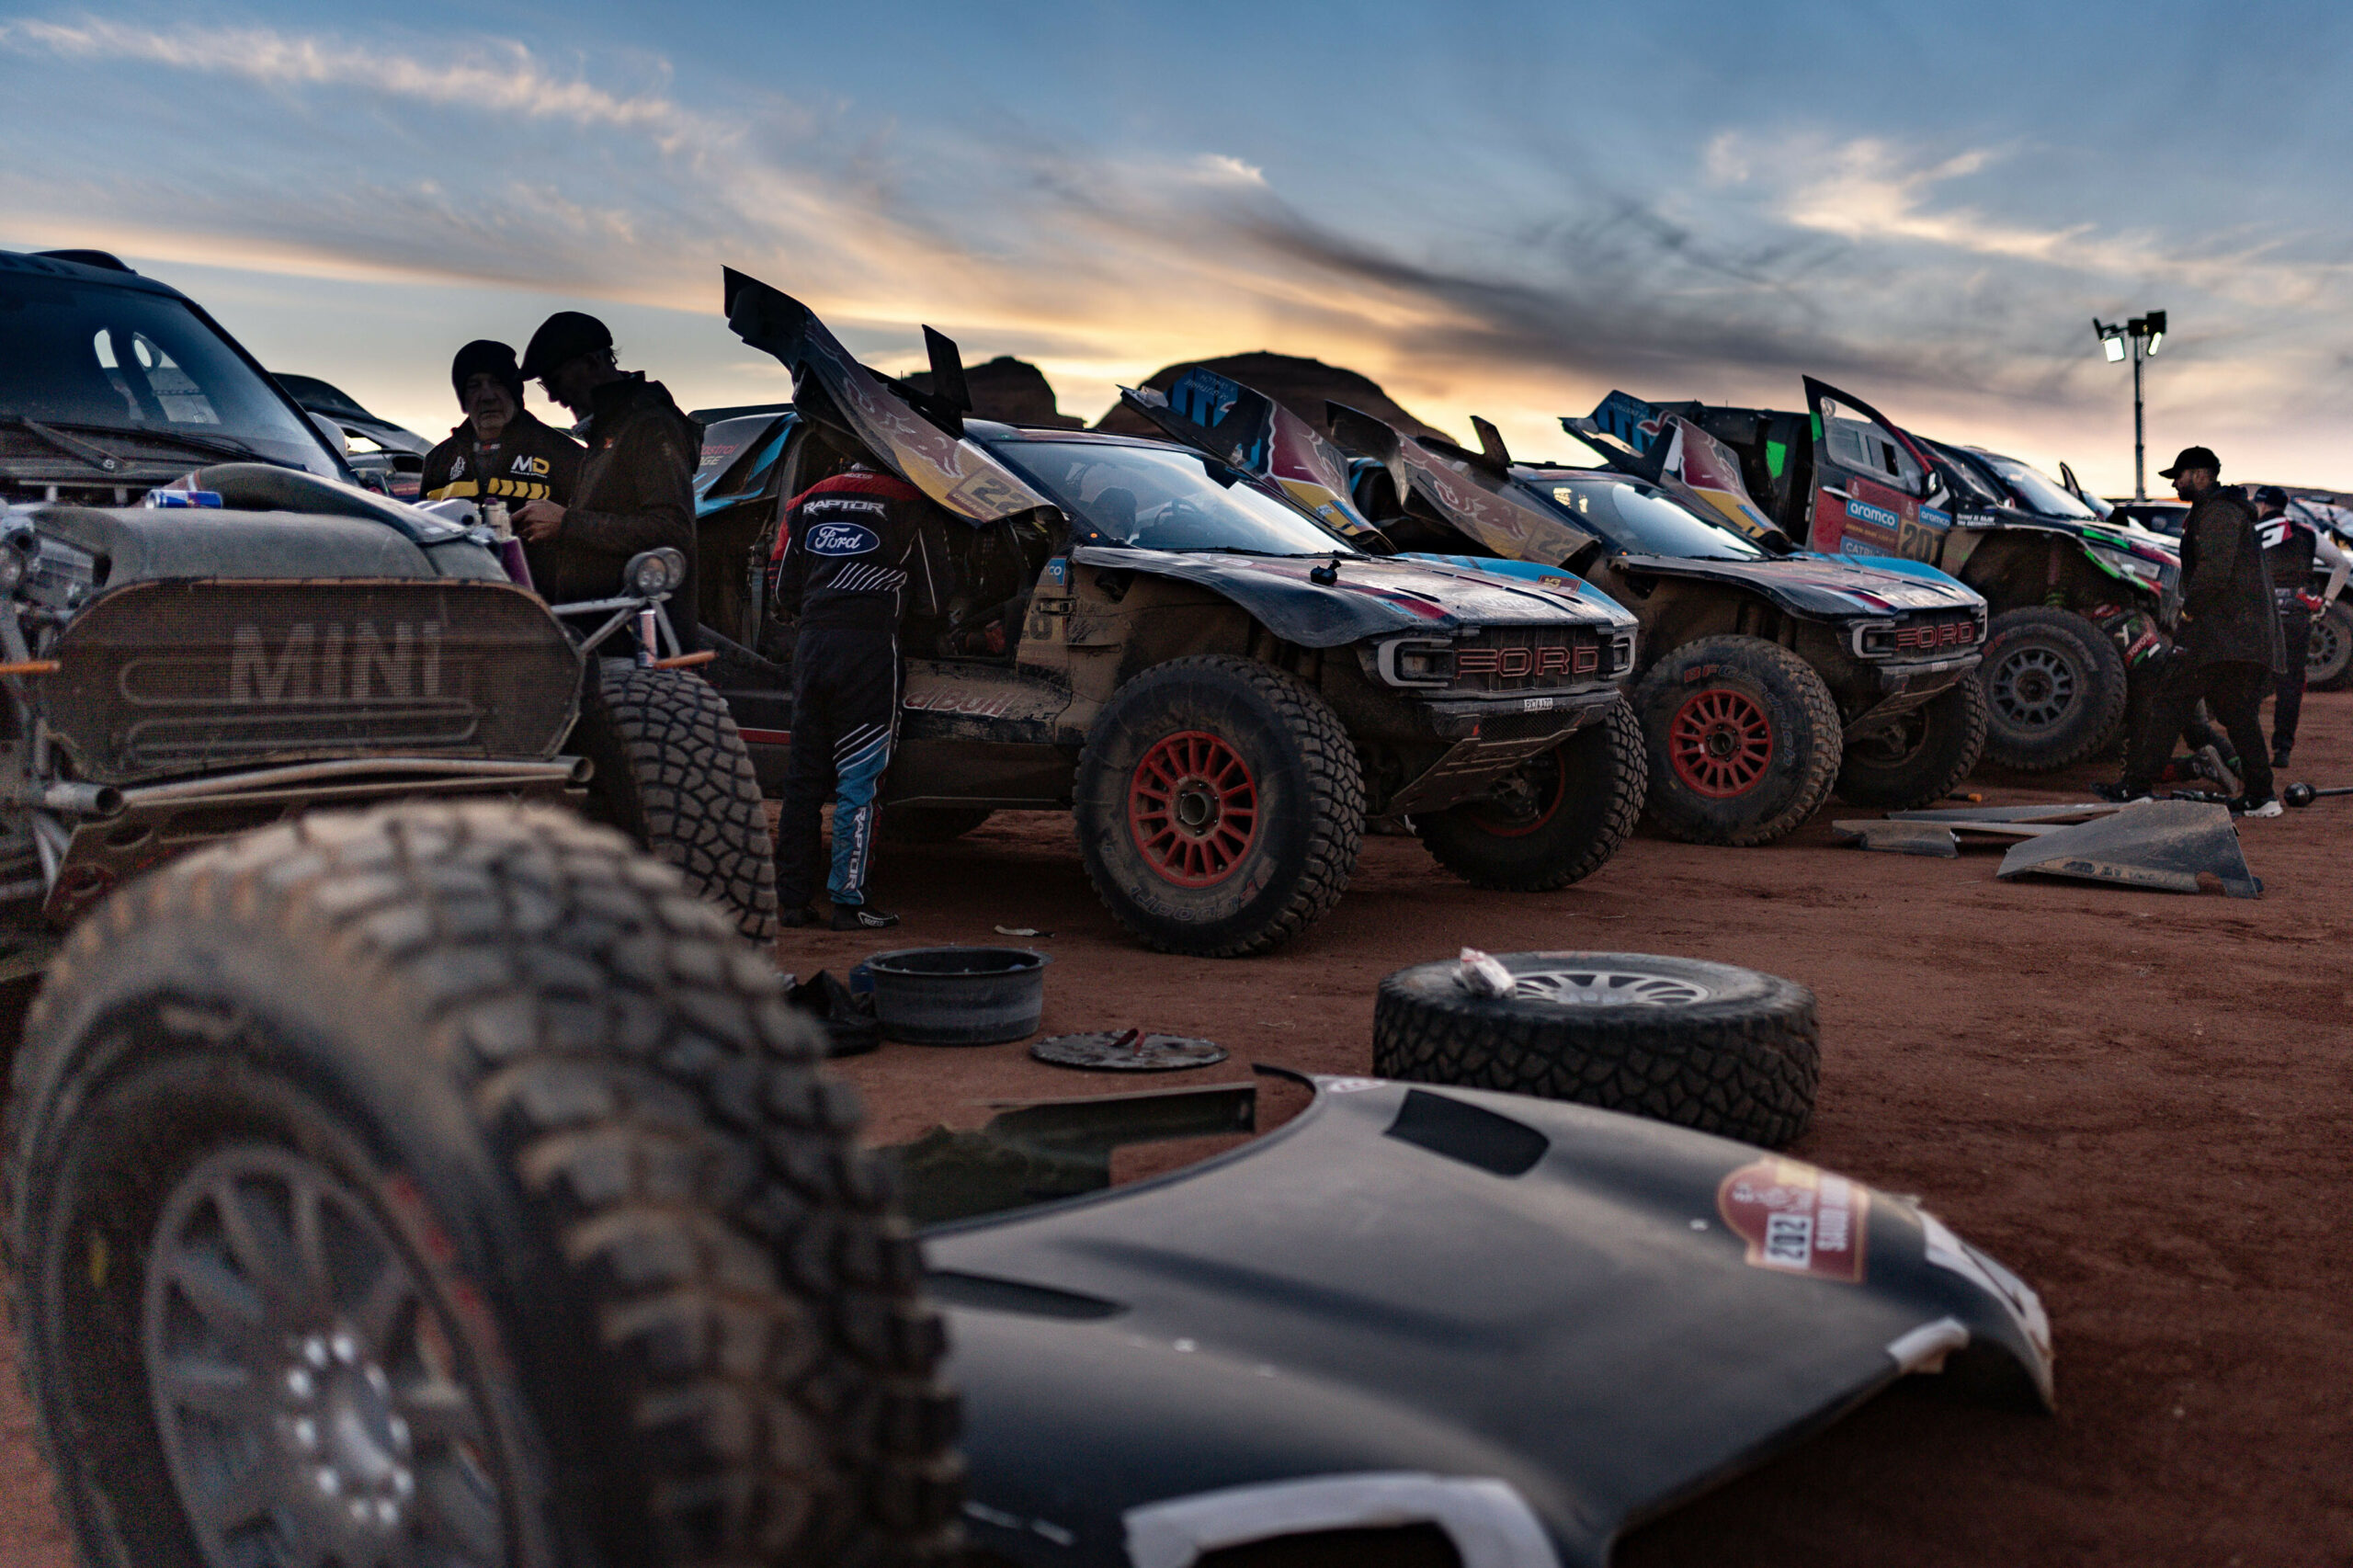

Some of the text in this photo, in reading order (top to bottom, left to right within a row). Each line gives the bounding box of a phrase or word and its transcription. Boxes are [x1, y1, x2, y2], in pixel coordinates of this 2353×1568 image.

[511, 454, 551, 475] MD
[802, 499, 888, 521] RAPTOR
[1850, 502, 1896, 527] aramco
[1920, 511, 1950, 528] aramco
[814, 526, 864, 550] Ford
[1894, 621, 1975, 652] FORD
[230, 621, 441, 705] MINI
[1453, 646, 1600, 680] FORD
[843, 806, 867, 890] RAPTOR
